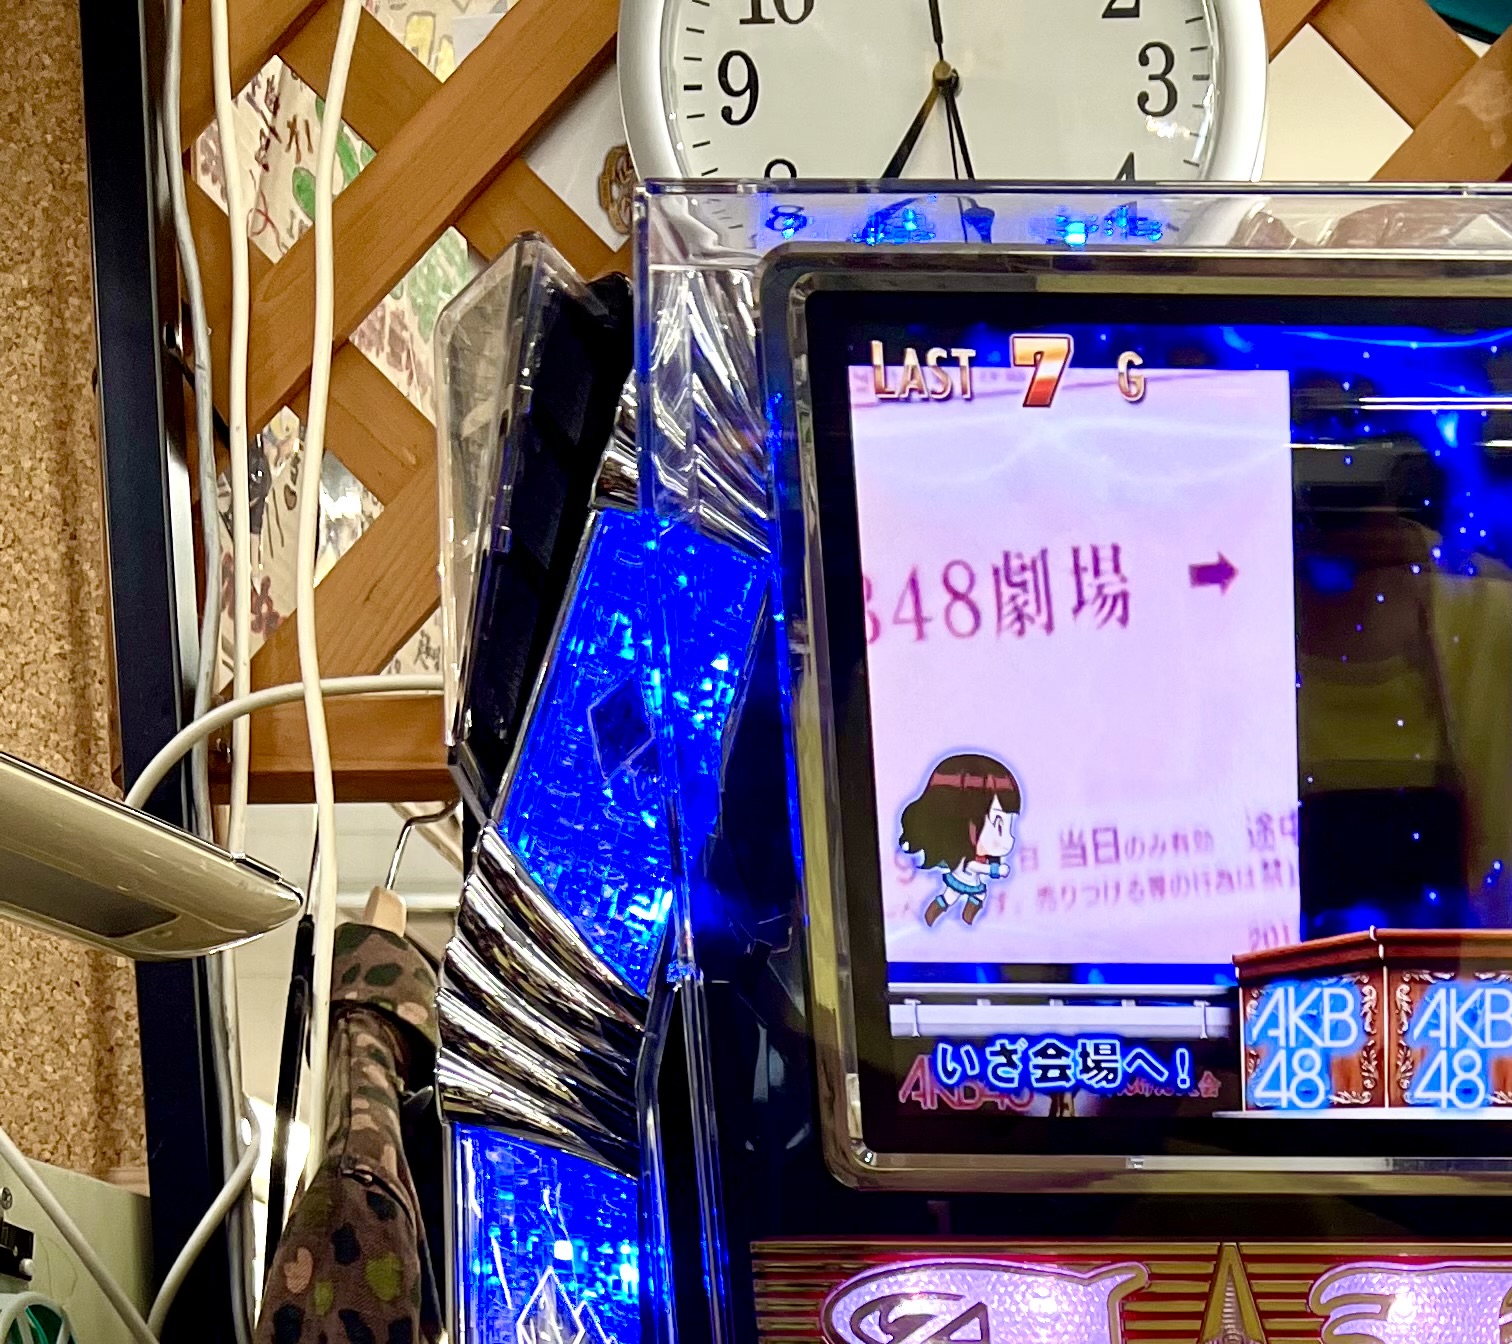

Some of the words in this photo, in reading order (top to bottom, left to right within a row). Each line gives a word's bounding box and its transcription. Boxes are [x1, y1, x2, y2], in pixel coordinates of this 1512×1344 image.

[718, 51, 760, 126] 9
[1137, 41, 1178, 118] 3
[869, 340, 977, 400] LAST
[1009, 332, 1075, 408] 7
[1117, 350, 1148, 402] G
[1251, 987, 1358, 1049] AKB
[936, 1037, 1193, 1088] いざ会場へ!
[1253, 1049, 1326, 1110] 48
[1413, 1049, 1483, 1110] 48
